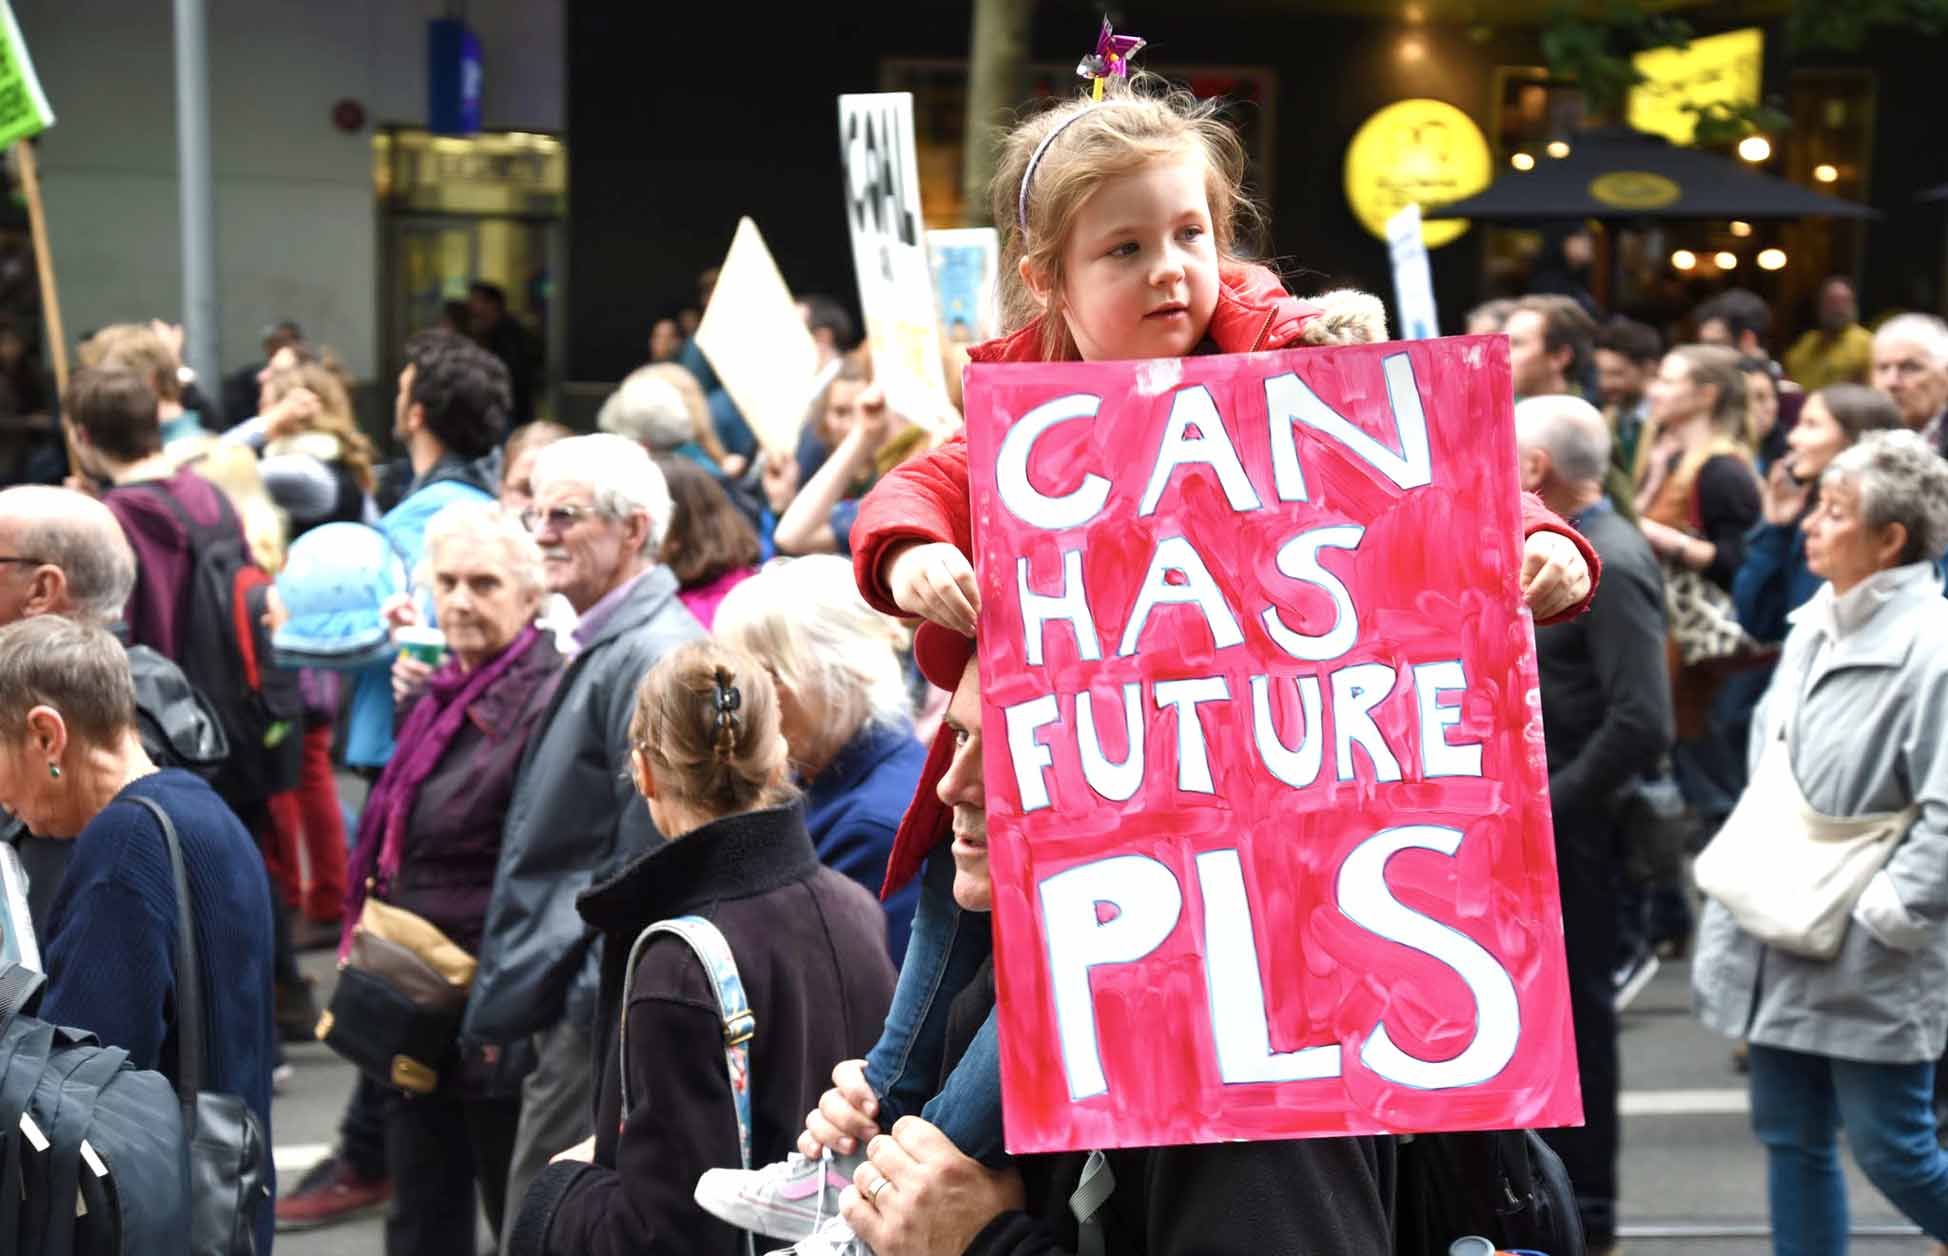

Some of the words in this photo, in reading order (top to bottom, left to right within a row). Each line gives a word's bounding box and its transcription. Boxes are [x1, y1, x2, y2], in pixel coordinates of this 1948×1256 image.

[995, 351, 1433, 531] CAN
[1015, 524, 1366, 668] HAS
[1003, 659, 1483, 813] FUTURE
[1038, 823, 1521, 1102] PLS
